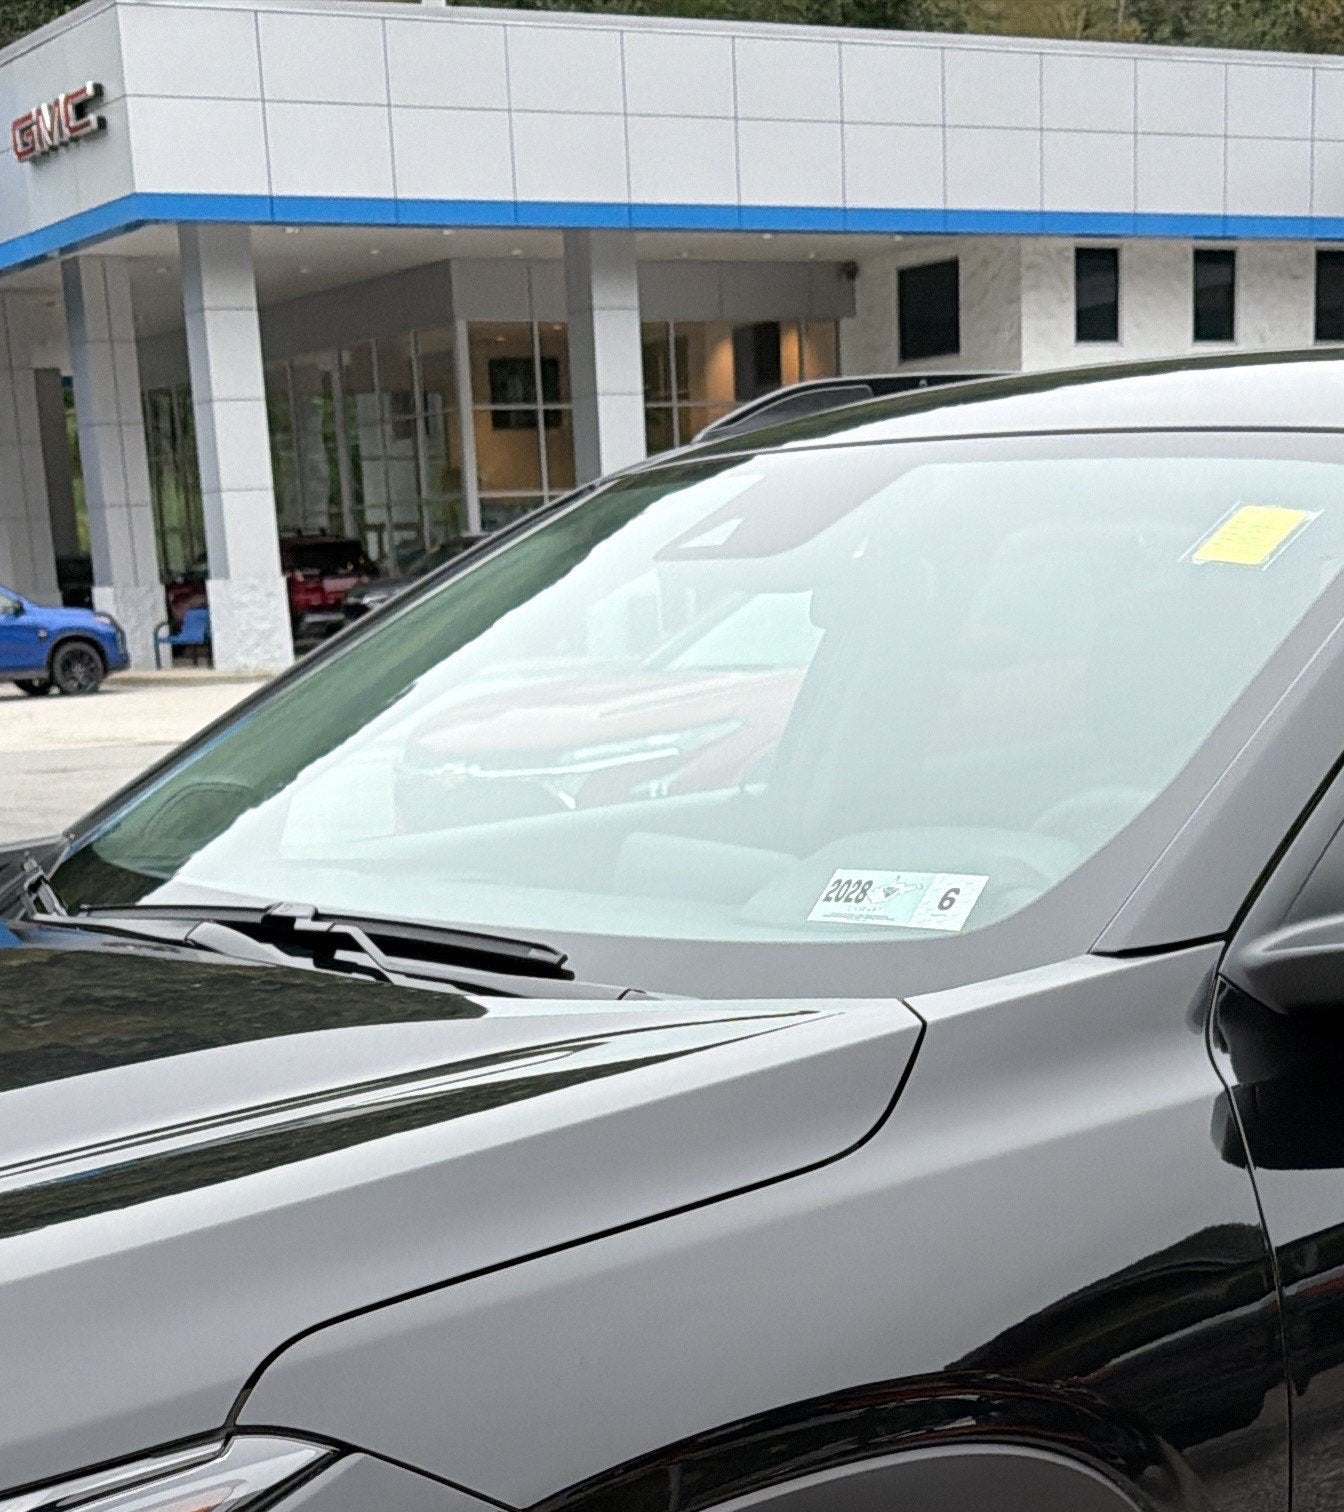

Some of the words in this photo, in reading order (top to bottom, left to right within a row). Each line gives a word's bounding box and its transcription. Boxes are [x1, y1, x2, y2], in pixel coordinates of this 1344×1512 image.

[11, 80, 98, 162] GMC
[822, 878, 874, 904] 2028
[937, 887, 960, 911] 6
